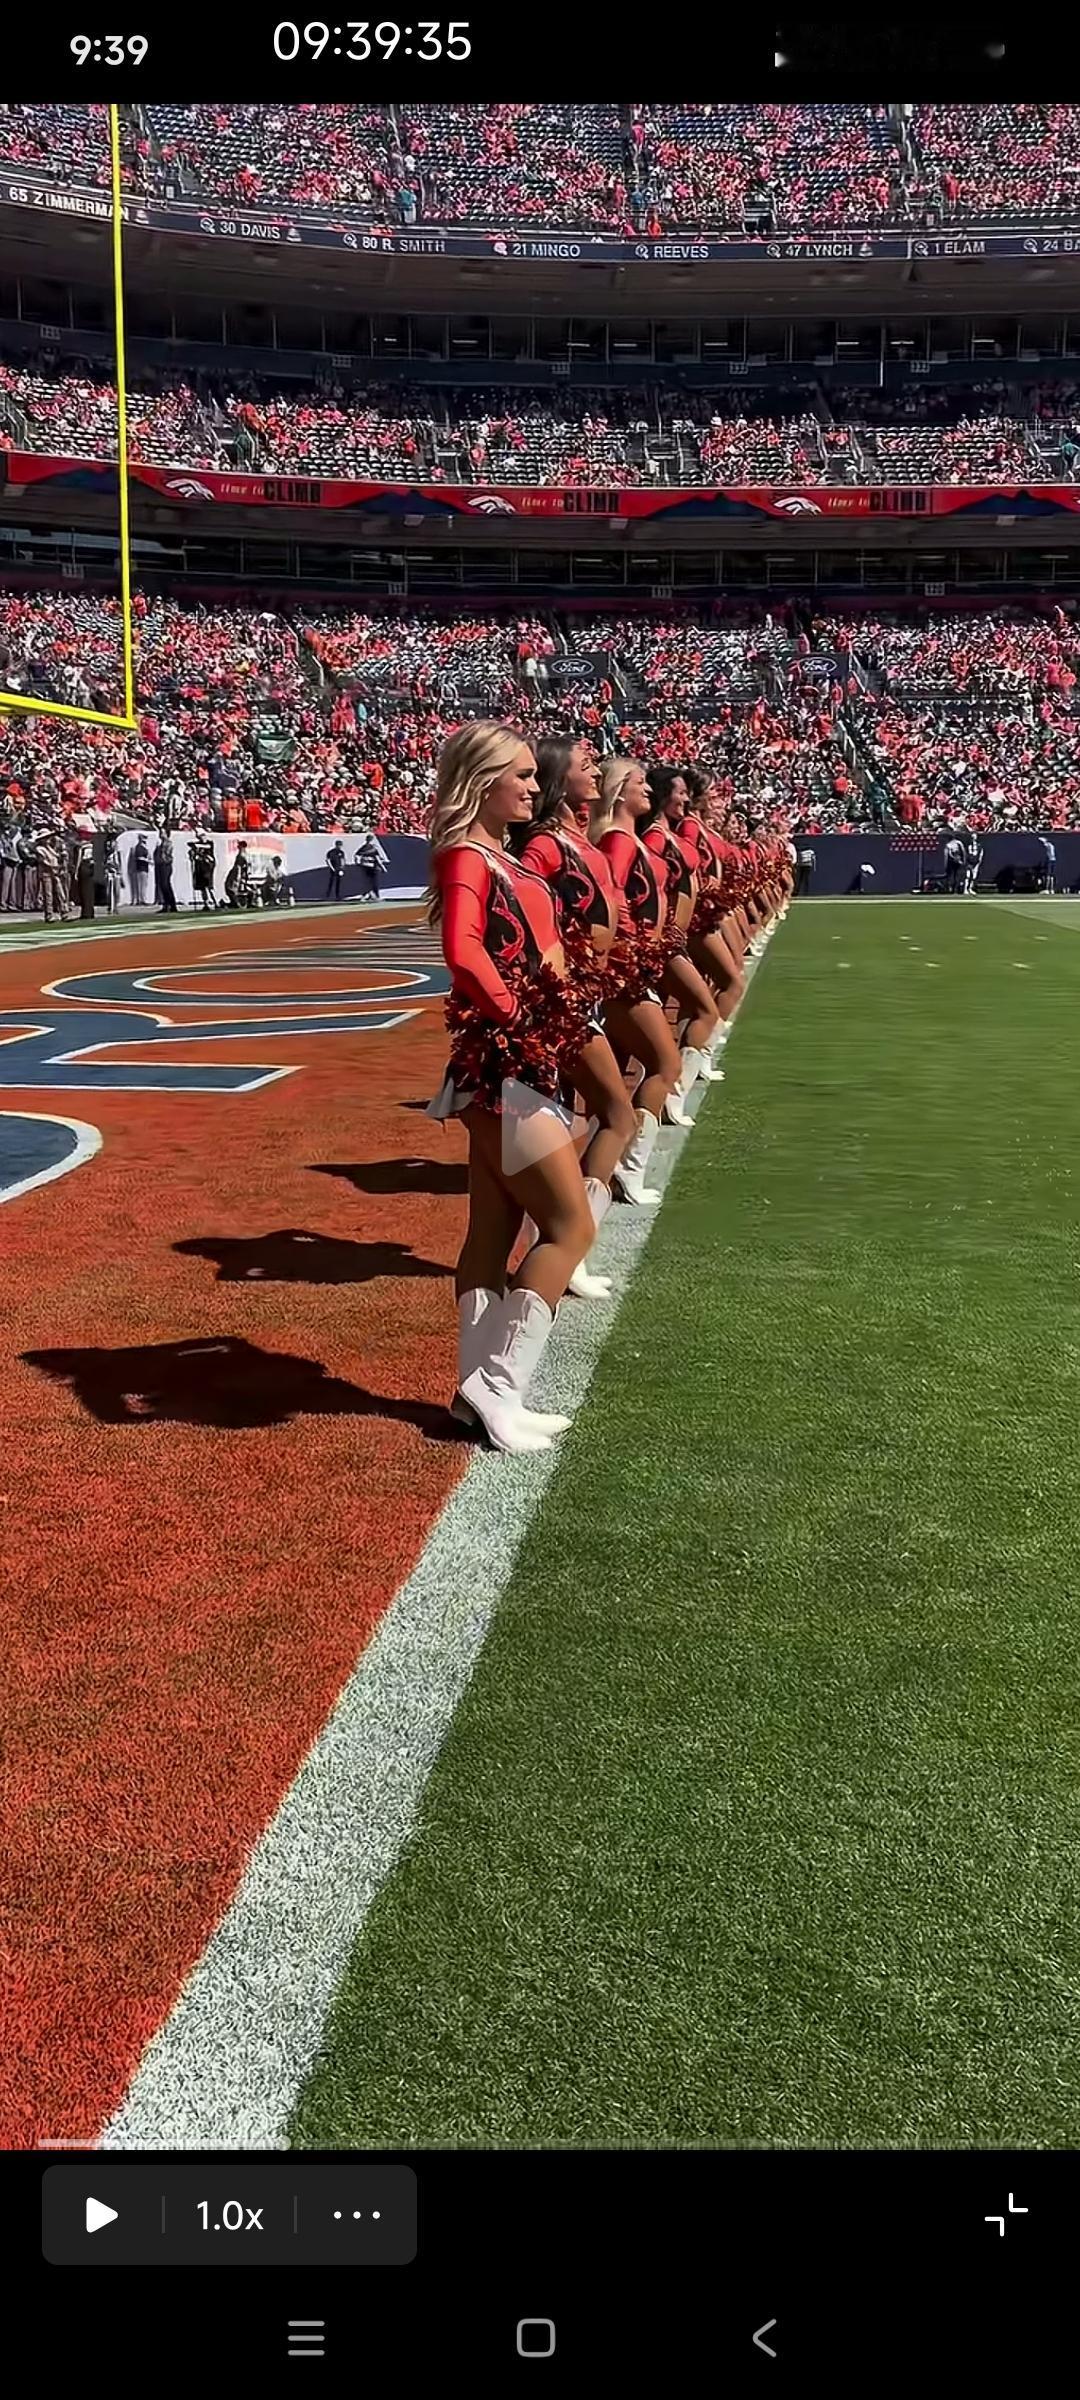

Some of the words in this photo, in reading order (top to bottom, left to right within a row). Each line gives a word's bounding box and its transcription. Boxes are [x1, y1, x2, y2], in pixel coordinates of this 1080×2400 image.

[9, 187, 28, 202] 65
[220, 221, 237, 234] 30
[241, 223, 280, 239] DAVIS
[400, 240, 446, 252] SMITH
[512, 243, 527, 256] 21
[531, 243, 580, 257] MINGO
[654, 245, 709, 258] REEVES
[785, 244, 801, 257] 47
[806, 244, 853, 257] LYNCH
[944, 241, 985, 254] ELAM
[1043, 239, 1058, 251] 24
